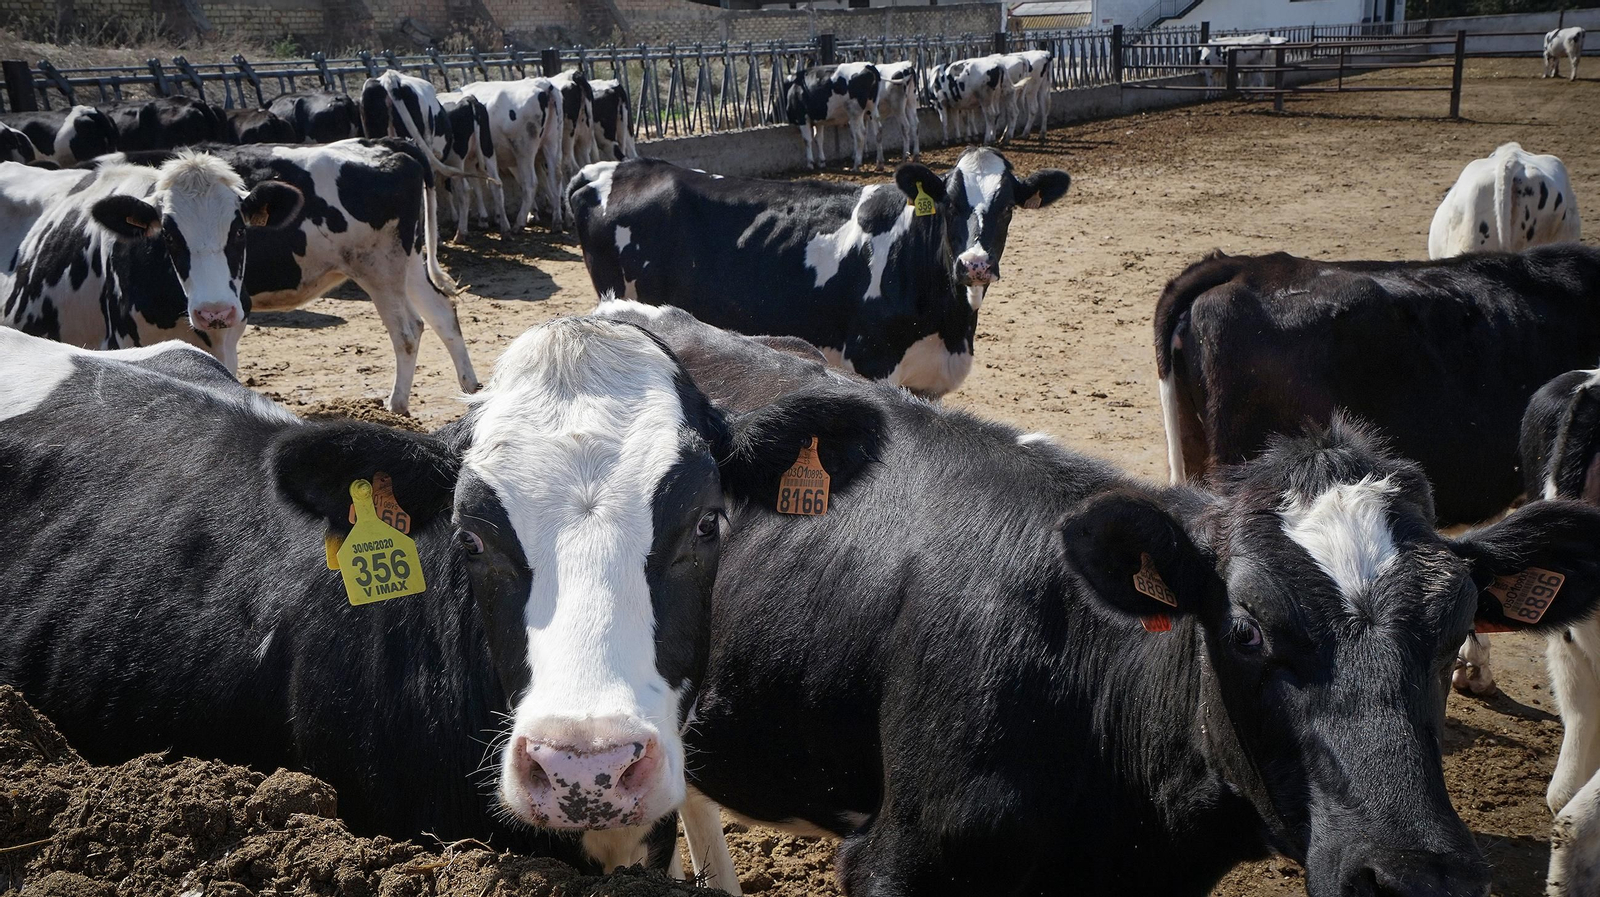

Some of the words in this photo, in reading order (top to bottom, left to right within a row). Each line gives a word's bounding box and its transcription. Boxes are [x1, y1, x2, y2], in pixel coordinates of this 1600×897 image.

[917, 200, 933, 211] 358
[780, 487, 825, 515] 8166
[351, 538, 394, 554] 30/06/2020
[351, 549, 411, 587] 356
[362, 587, 372, 597] V
[375, 580, 409, 595] IMAX
[1136, 575, 1175, 604] 8896
[1518, 573, 1561, 620] 8896
